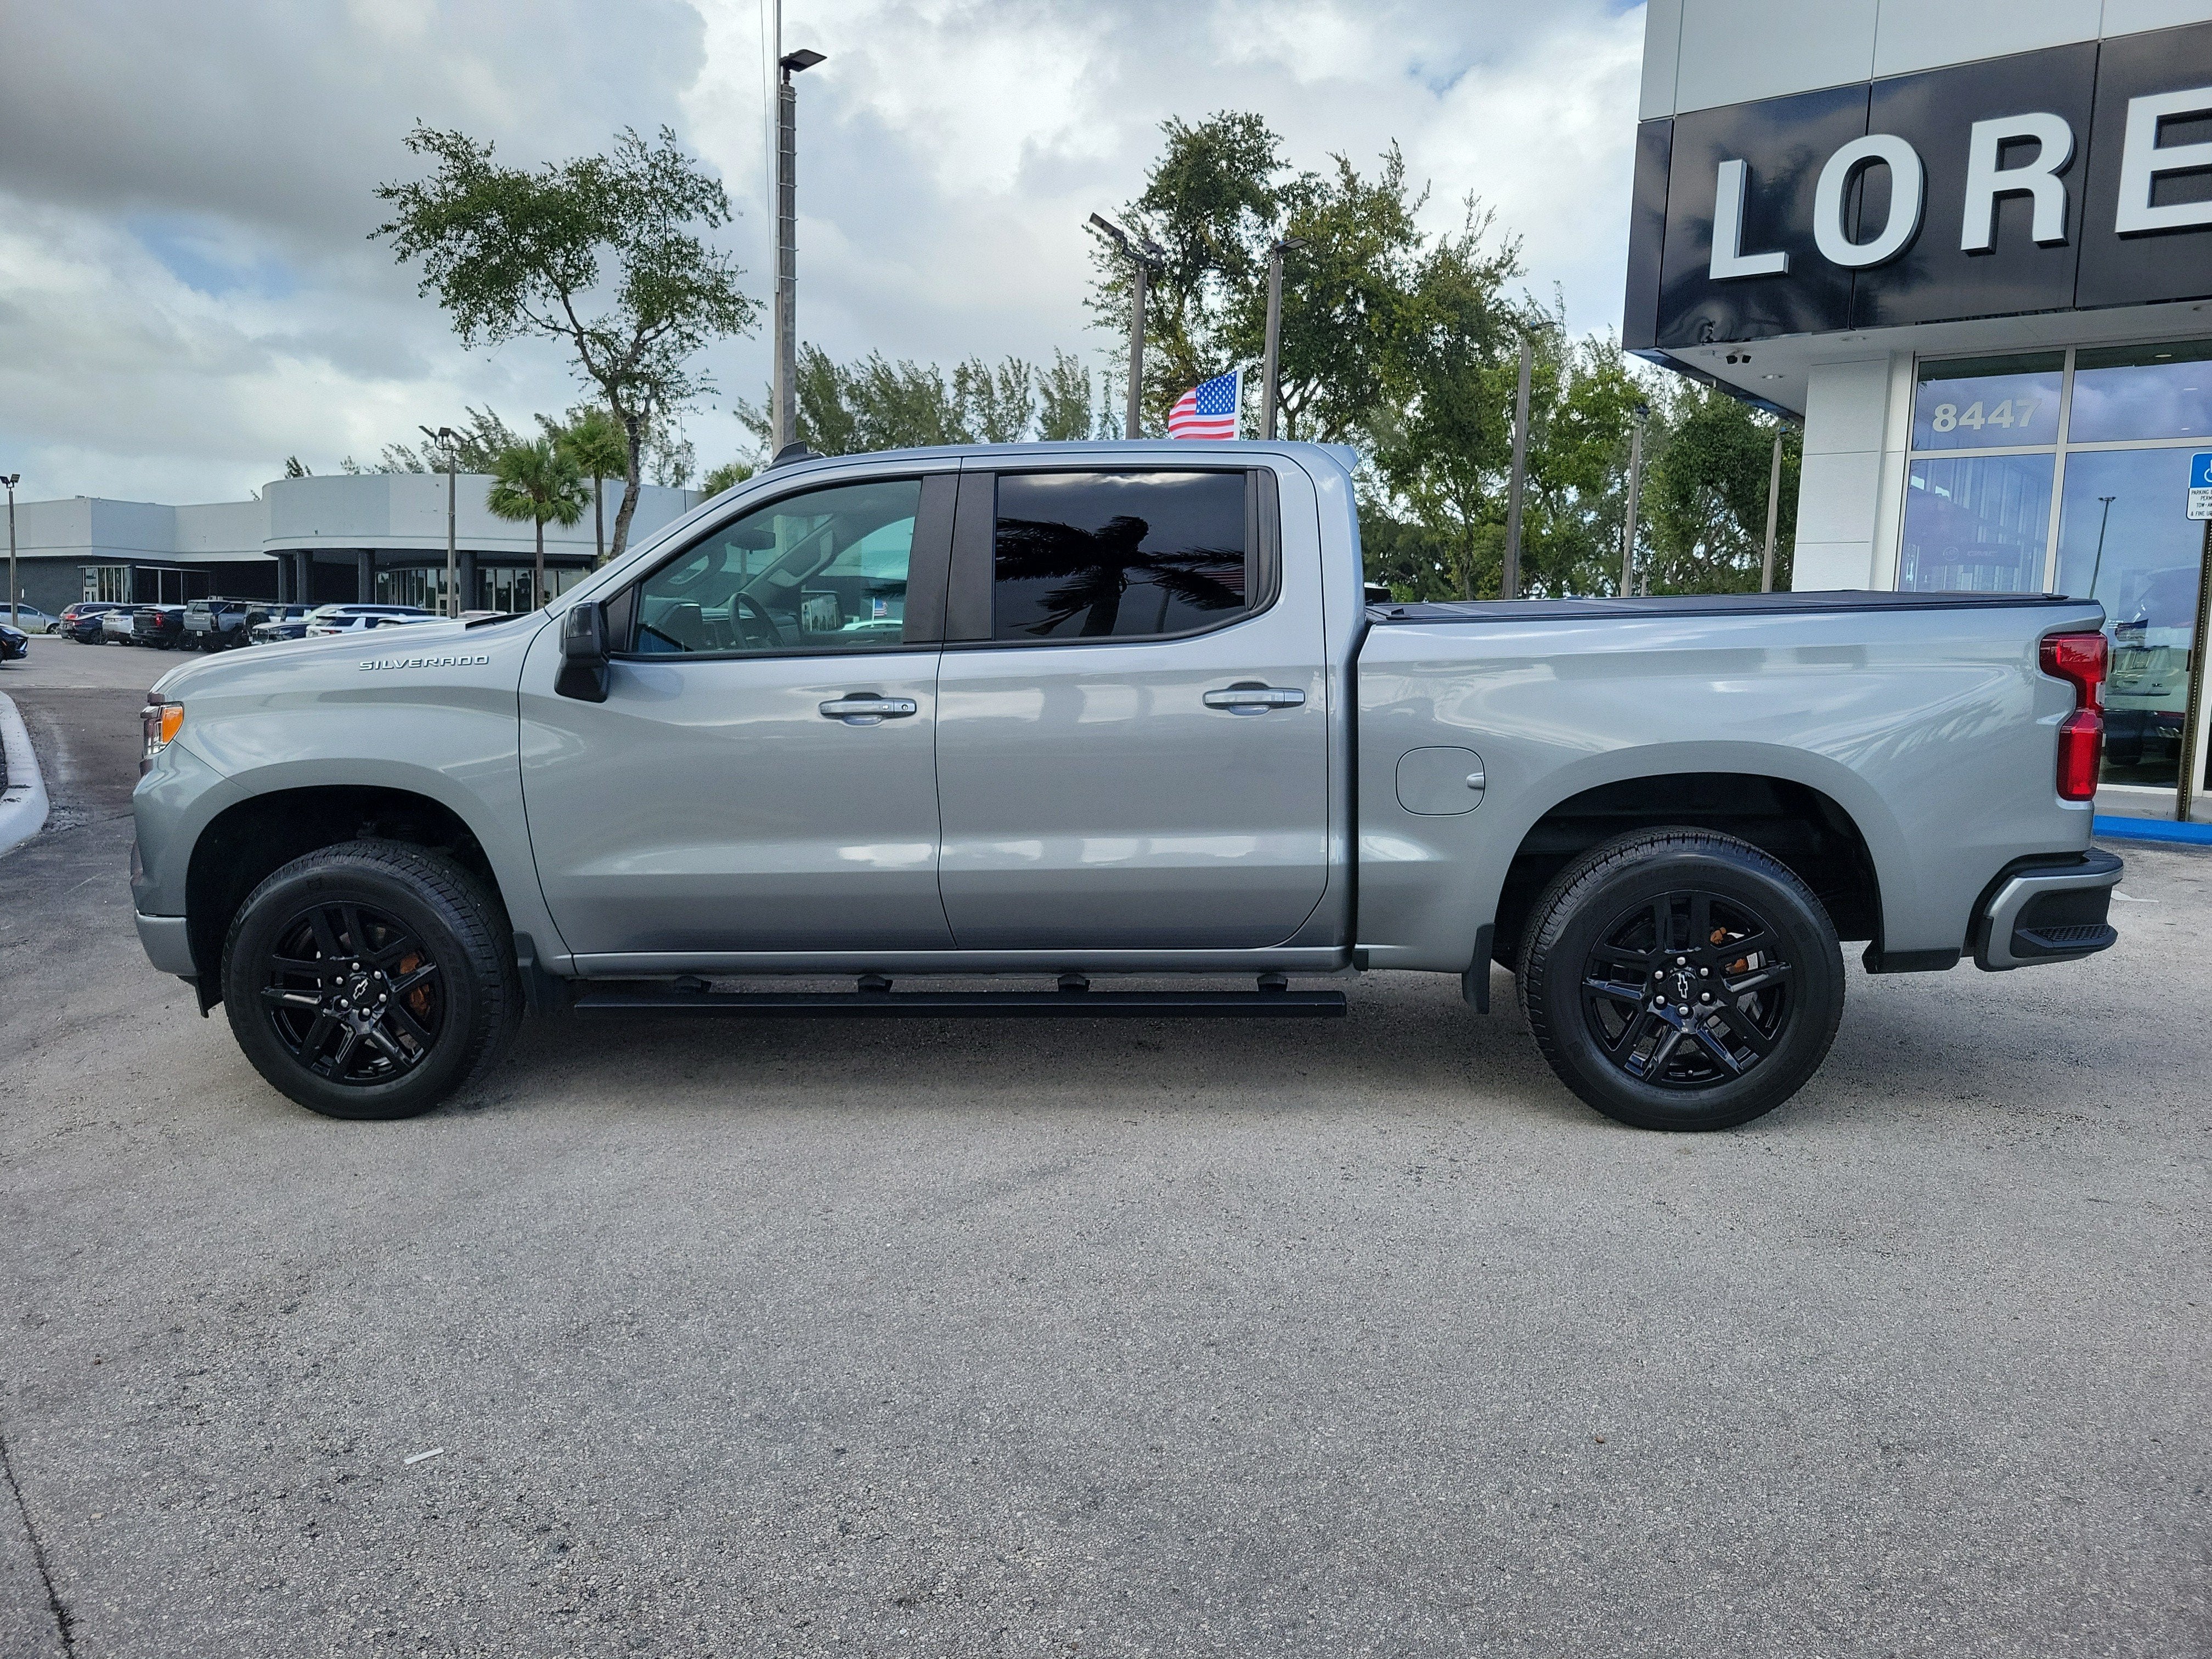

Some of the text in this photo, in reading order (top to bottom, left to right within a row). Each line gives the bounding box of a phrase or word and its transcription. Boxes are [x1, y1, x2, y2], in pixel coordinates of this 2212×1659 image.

[1709, 87, 2212, 280] LORE
[1933, 398, 2042, 433] 8447
[359, 656, 490, 671] SILVERADO
